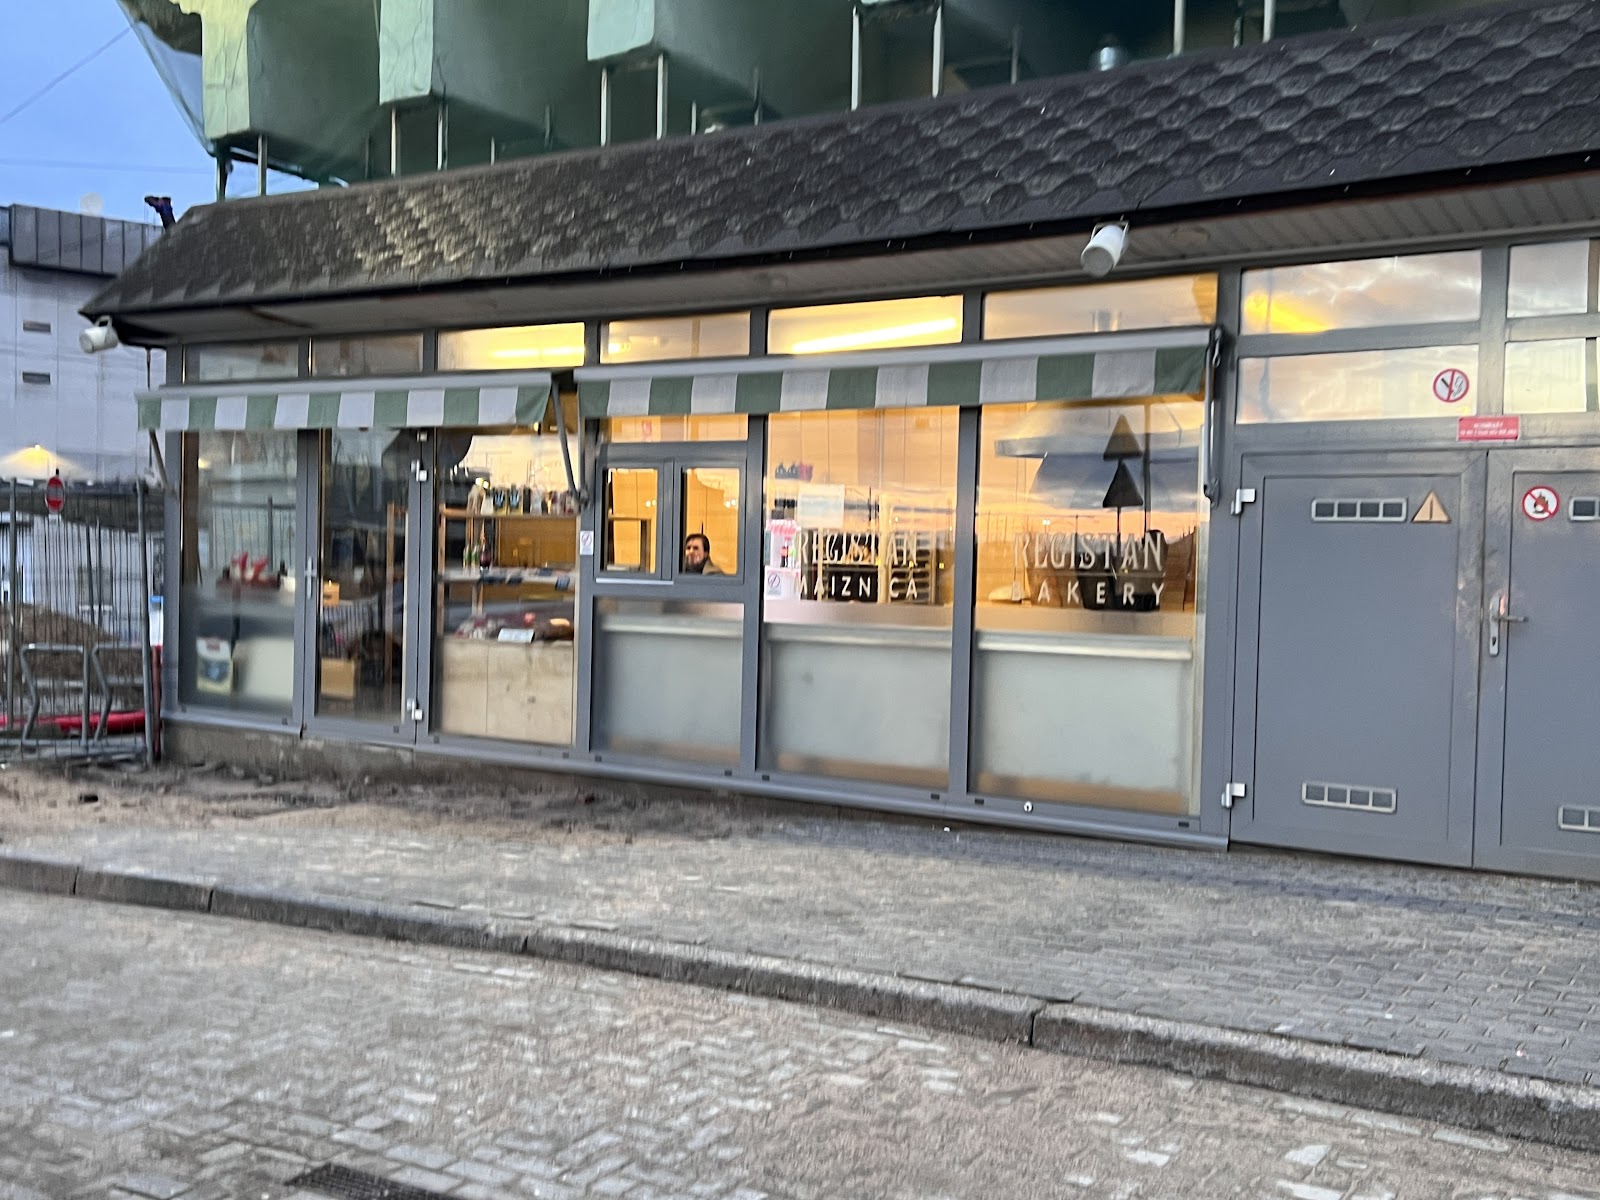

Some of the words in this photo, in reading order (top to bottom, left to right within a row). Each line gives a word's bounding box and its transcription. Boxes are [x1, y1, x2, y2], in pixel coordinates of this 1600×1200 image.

[1013, 532, 1165, 572] REGISTAN
[793, 574, 918, 600] MAIZNCA
[1011, 579, 1165, 606] BAKERY
